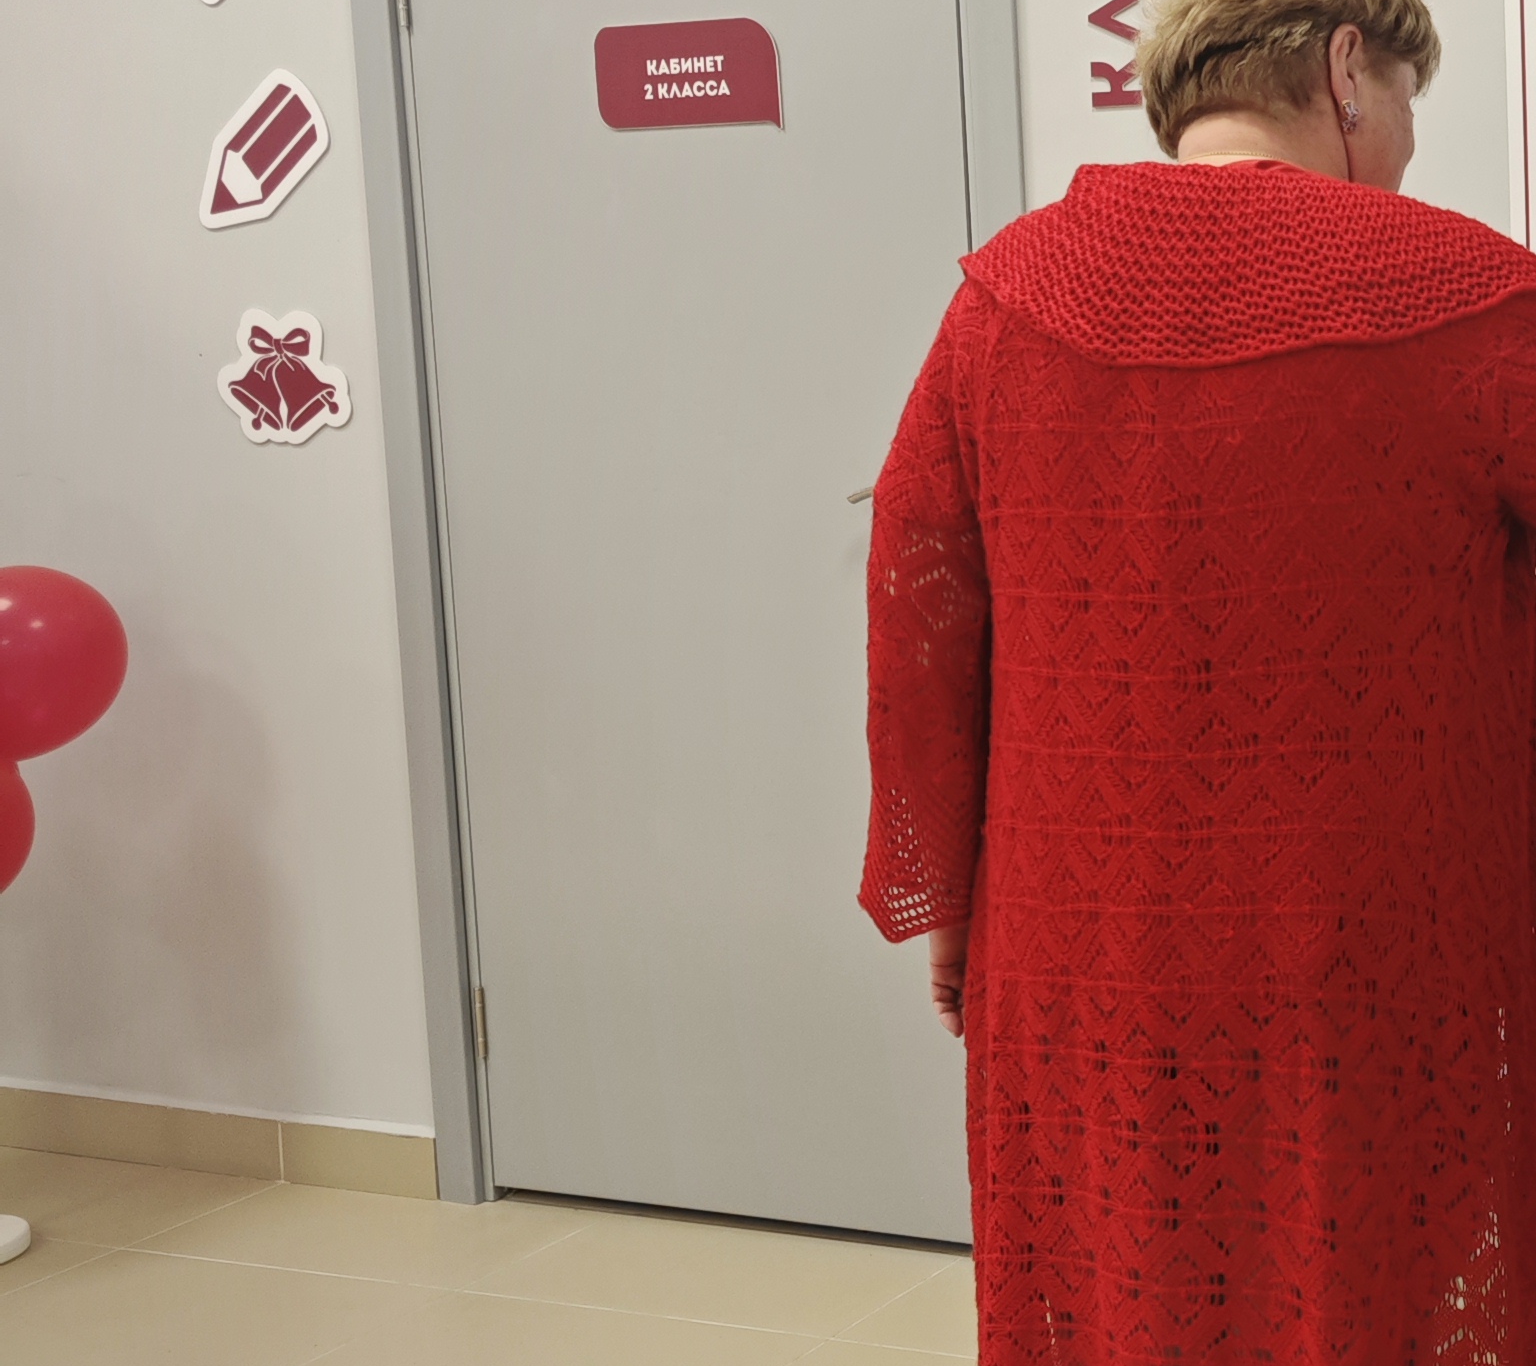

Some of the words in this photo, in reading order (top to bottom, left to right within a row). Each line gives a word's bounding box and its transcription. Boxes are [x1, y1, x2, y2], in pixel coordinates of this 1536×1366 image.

[645, 54, 725, 76] КАБИНЕТ
[643, 83, 654, 100] 2
[657, 79, 731, 100] КЛАССА
